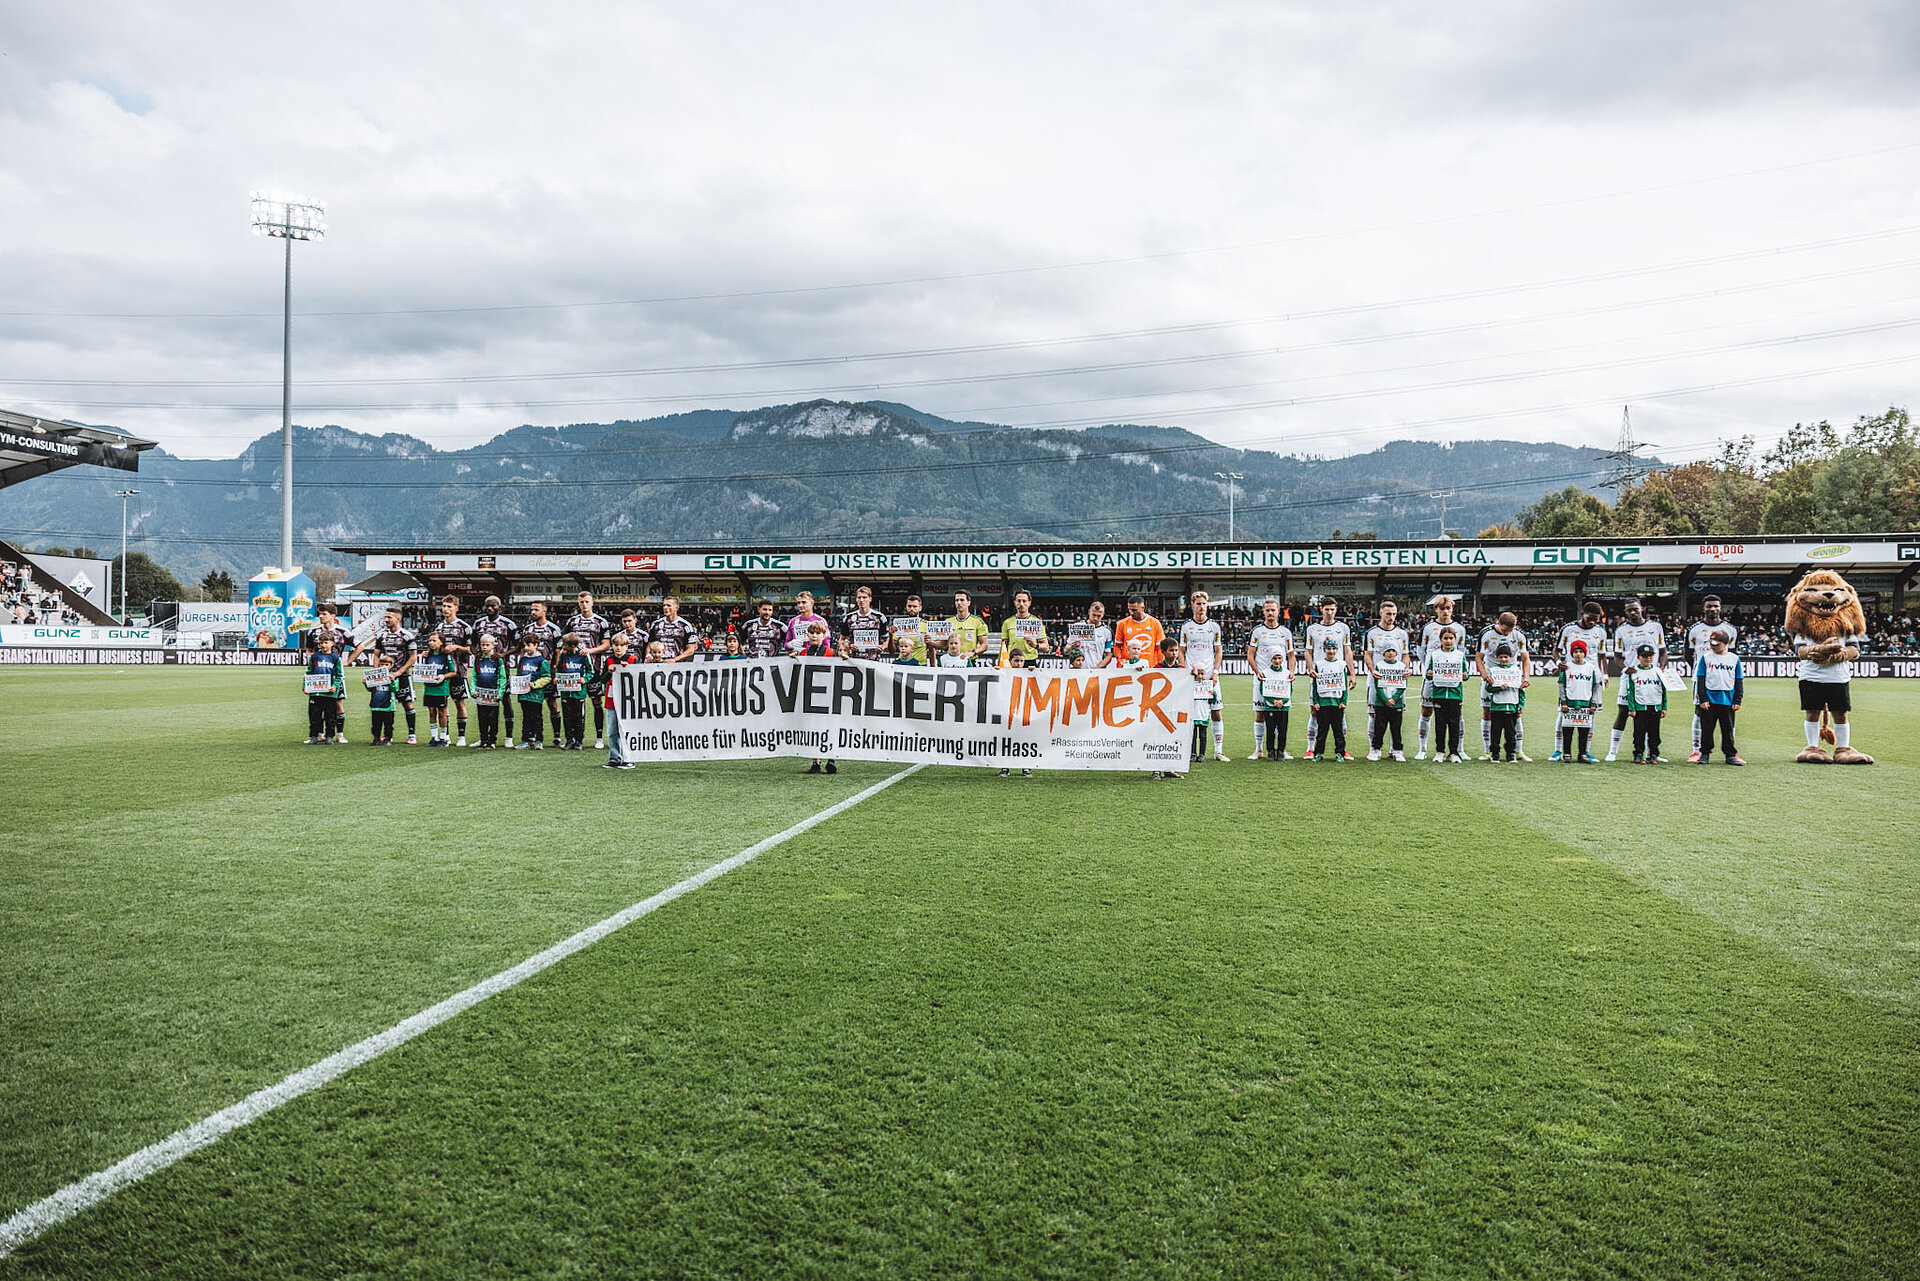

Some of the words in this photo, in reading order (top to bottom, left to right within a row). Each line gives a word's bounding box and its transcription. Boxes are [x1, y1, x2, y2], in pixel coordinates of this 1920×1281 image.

[1700, 545, 1719, 555] BAD
[1724, 544, 1744, 554] DOG
[825, 554, 901, 569] UNSERE
[908, 554, 999, 568] WINNING
[1008, 553, 1064, 568] FOOD
[1074, 552, 1159, 568] BRANDS
[1167, 552, 1254, 567] SPIELEN
[1262, 551, 1283, 566] IN
[1292, 551, 1333, 566] DER
[1343, 550, 1426, 566] ERSTEN
[1436, 549, 1495, 565] LIGA.
[1533, 548, 1640, 564] GUNZ
[395, 560, 442, 569] Stiratini
[705, 556, 791, 569] GUNZ
[591, 584, 632, 595] Waibel
[680, 584, 731, 594] Raiffeisen
[34, 628, 81, 638] GUNZ
[108, 630, 150, 639] GUNZ
[86, 650, 98, 664] IM
[100, 650, 142, 664] BUSINESS
[143, 650, 164, 664] CLUB
[1716, 662, 1734, 671] vkw
[1758, 662, 1776, 677] IM
[620, 666, 766, 720] RASSISMUS
[770, 664, 1002, 725] VERLIERT.
[1008, 672, 1188, 734] IMMER.
[662, 730, 709, 750] Chance
[712, 728, 736, 749] für
[838, 728, 964, 760] Diskriminierung
[968, 736, 999, 758] und
[1001, 737, 1043, 759] Hass.
[1051, 738, 1134, 748] #RassismusVerliert
[1065, 750, 1122, 760] #KeineGewalt
